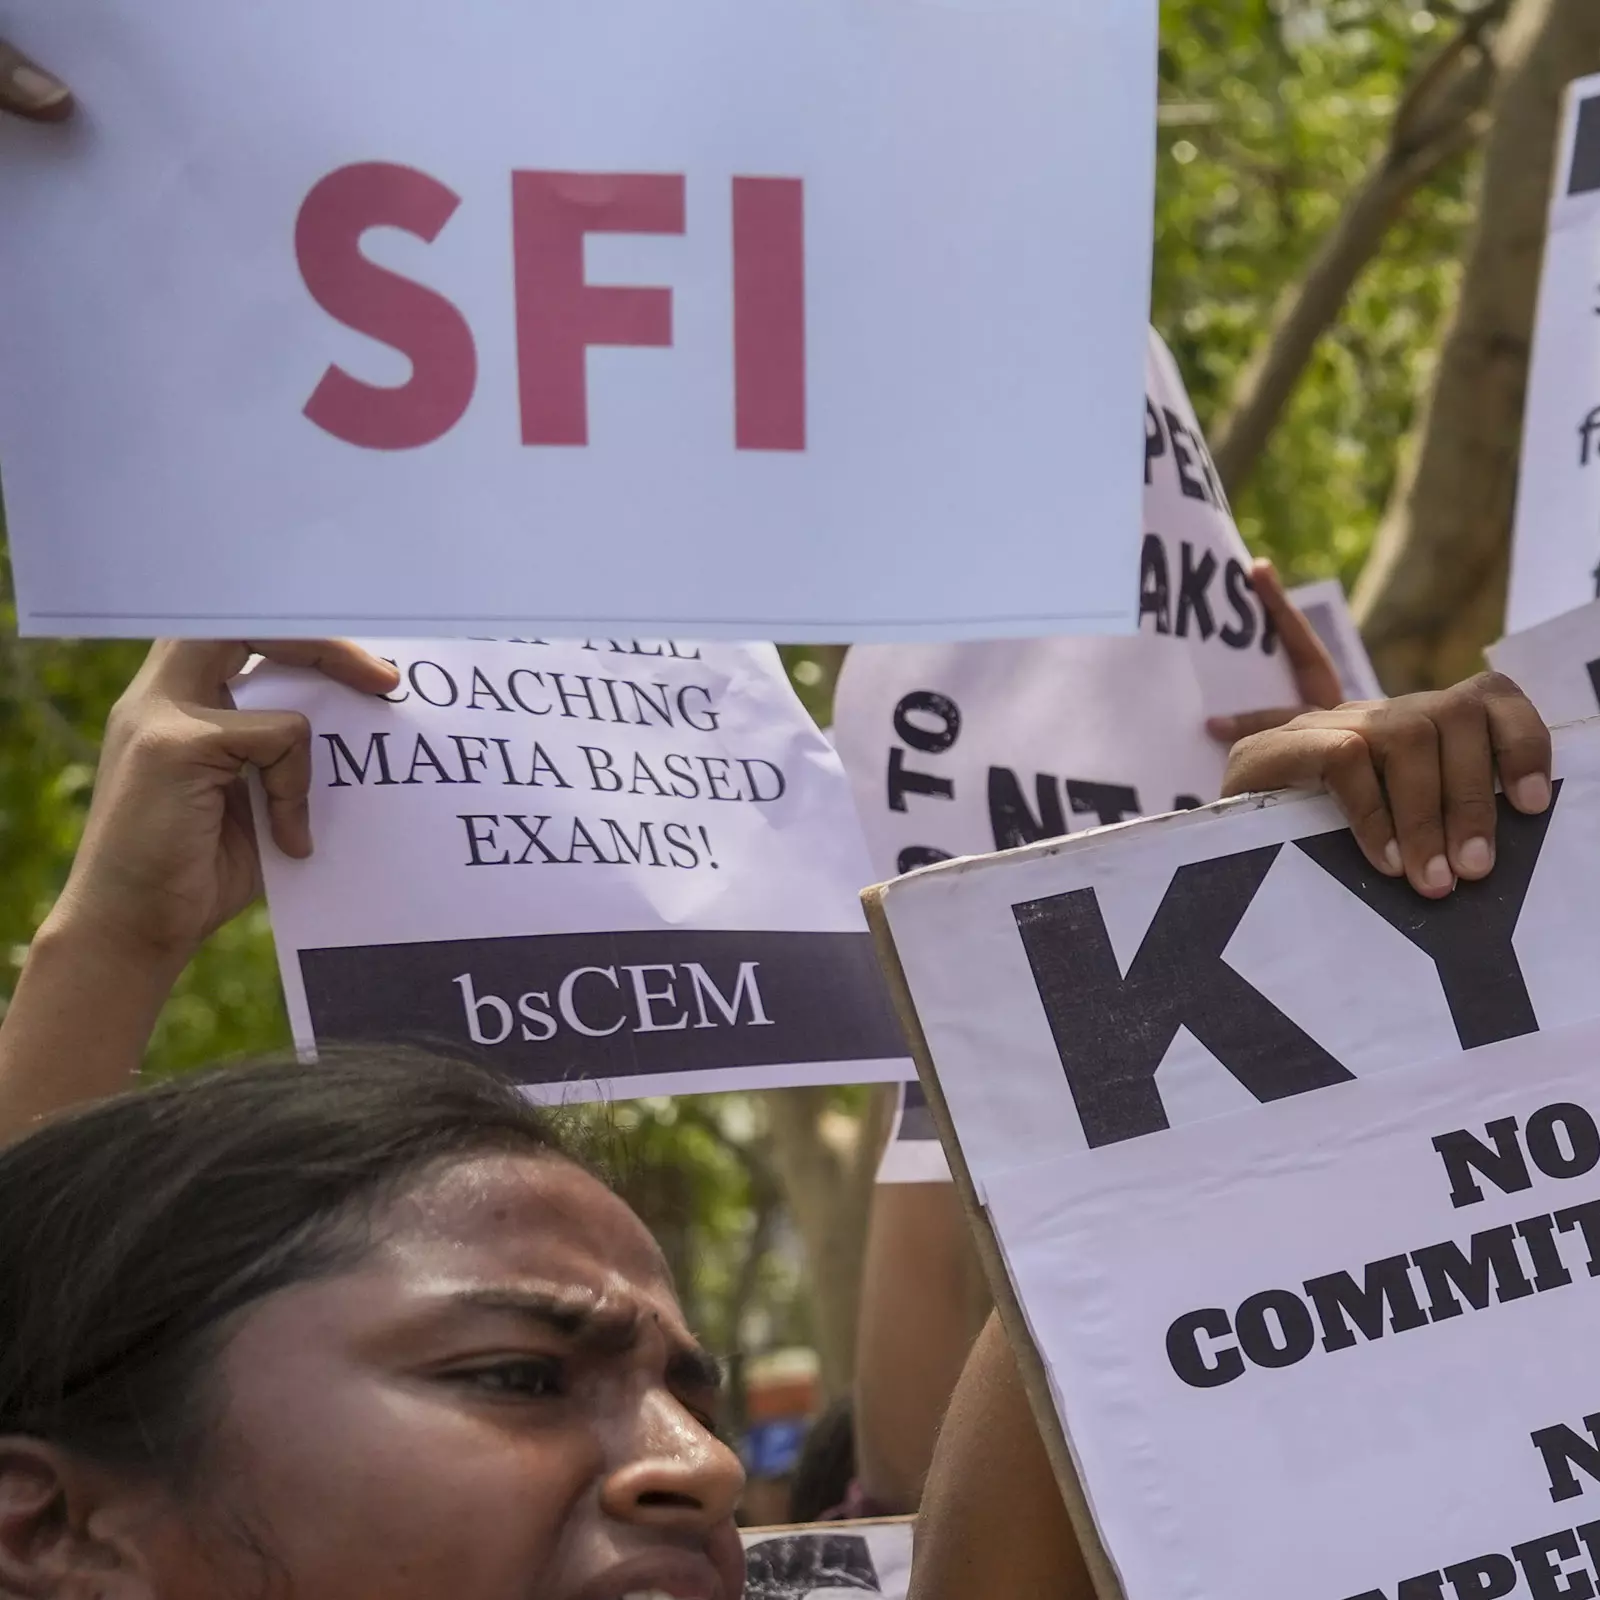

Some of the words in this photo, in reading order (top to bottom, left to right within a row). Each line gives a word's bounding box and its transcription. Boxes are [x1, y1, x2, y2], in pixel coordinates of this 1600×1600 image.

[294, 159, 806, 452] SFI
[320, 731, 573, 788] MAFIA
[577, 744, 786, 803] BASED
[456, 814, 720, 870] EXAMS!
[453, 960, 775, 1045] bsCEM
